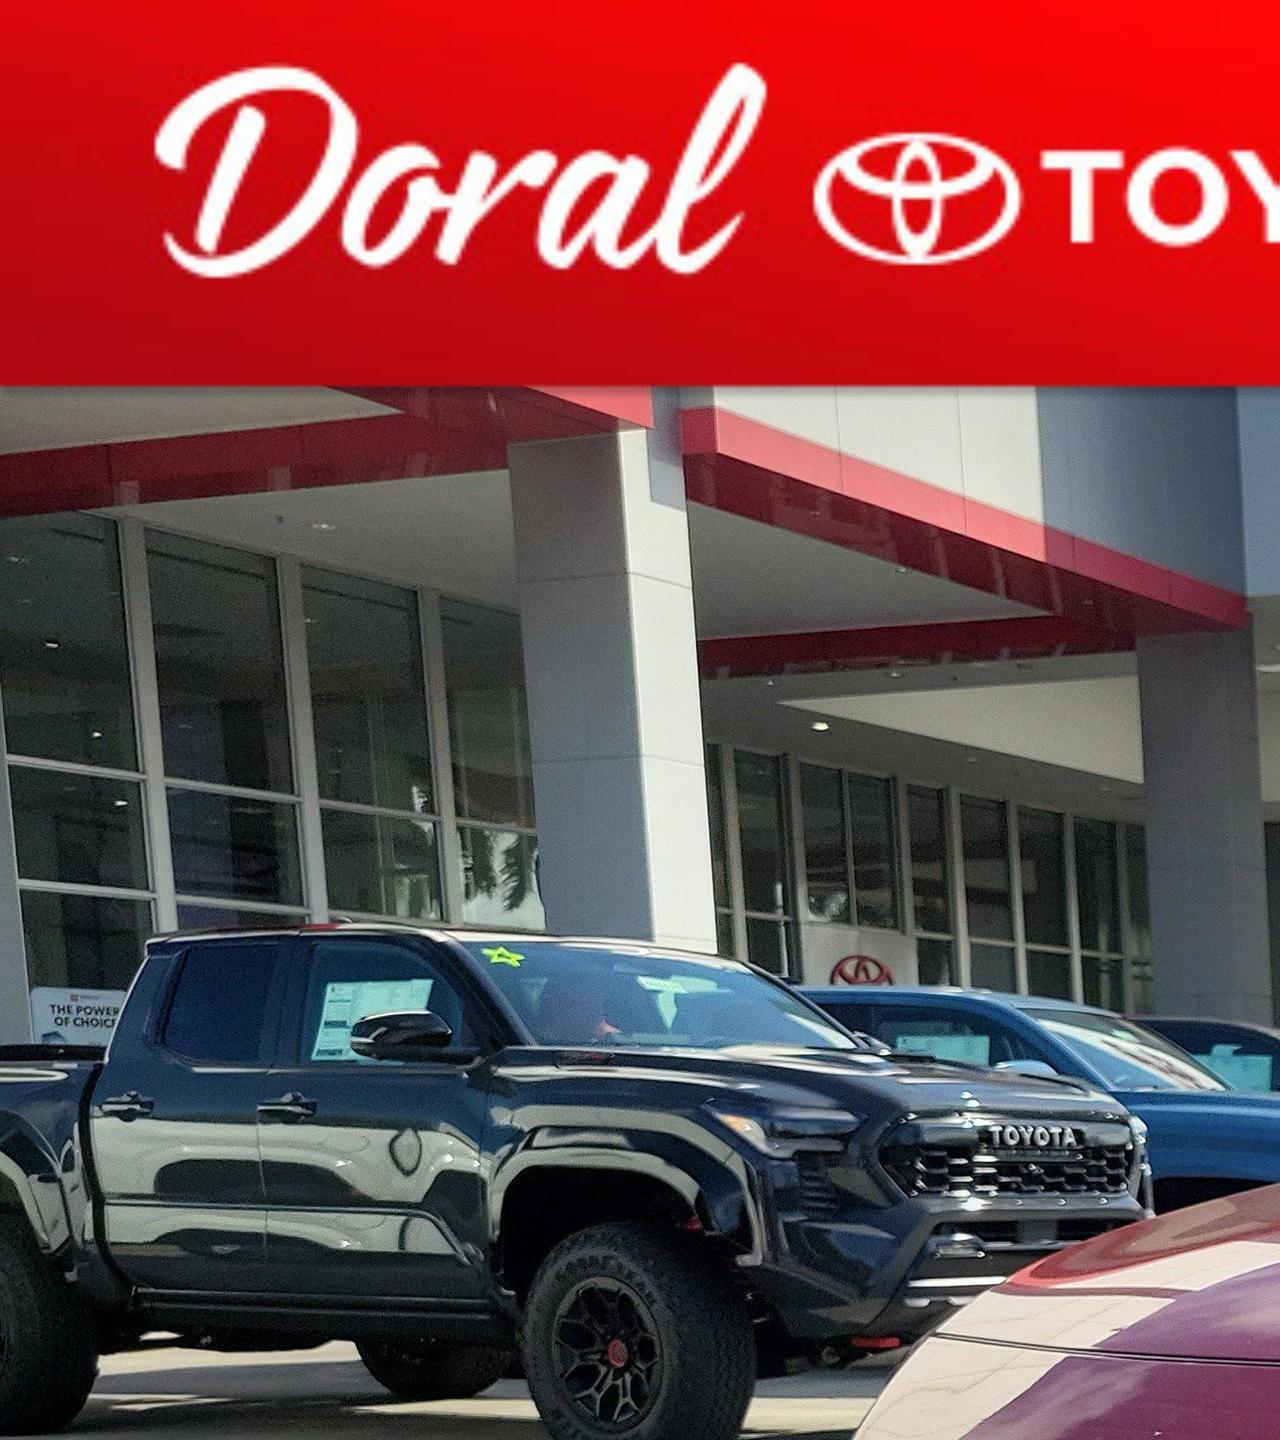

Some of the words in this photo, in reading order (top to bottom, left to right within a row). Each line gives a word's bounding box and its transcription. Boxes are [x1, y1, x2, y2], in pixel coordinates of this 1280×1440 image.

[50, 1004, 73, 1015] THE
[76, 1004, 120, 1016] POWER
[54, 1017, 70, 1027] OF
[988, 1126, 1077, 1147] TOYOTA
